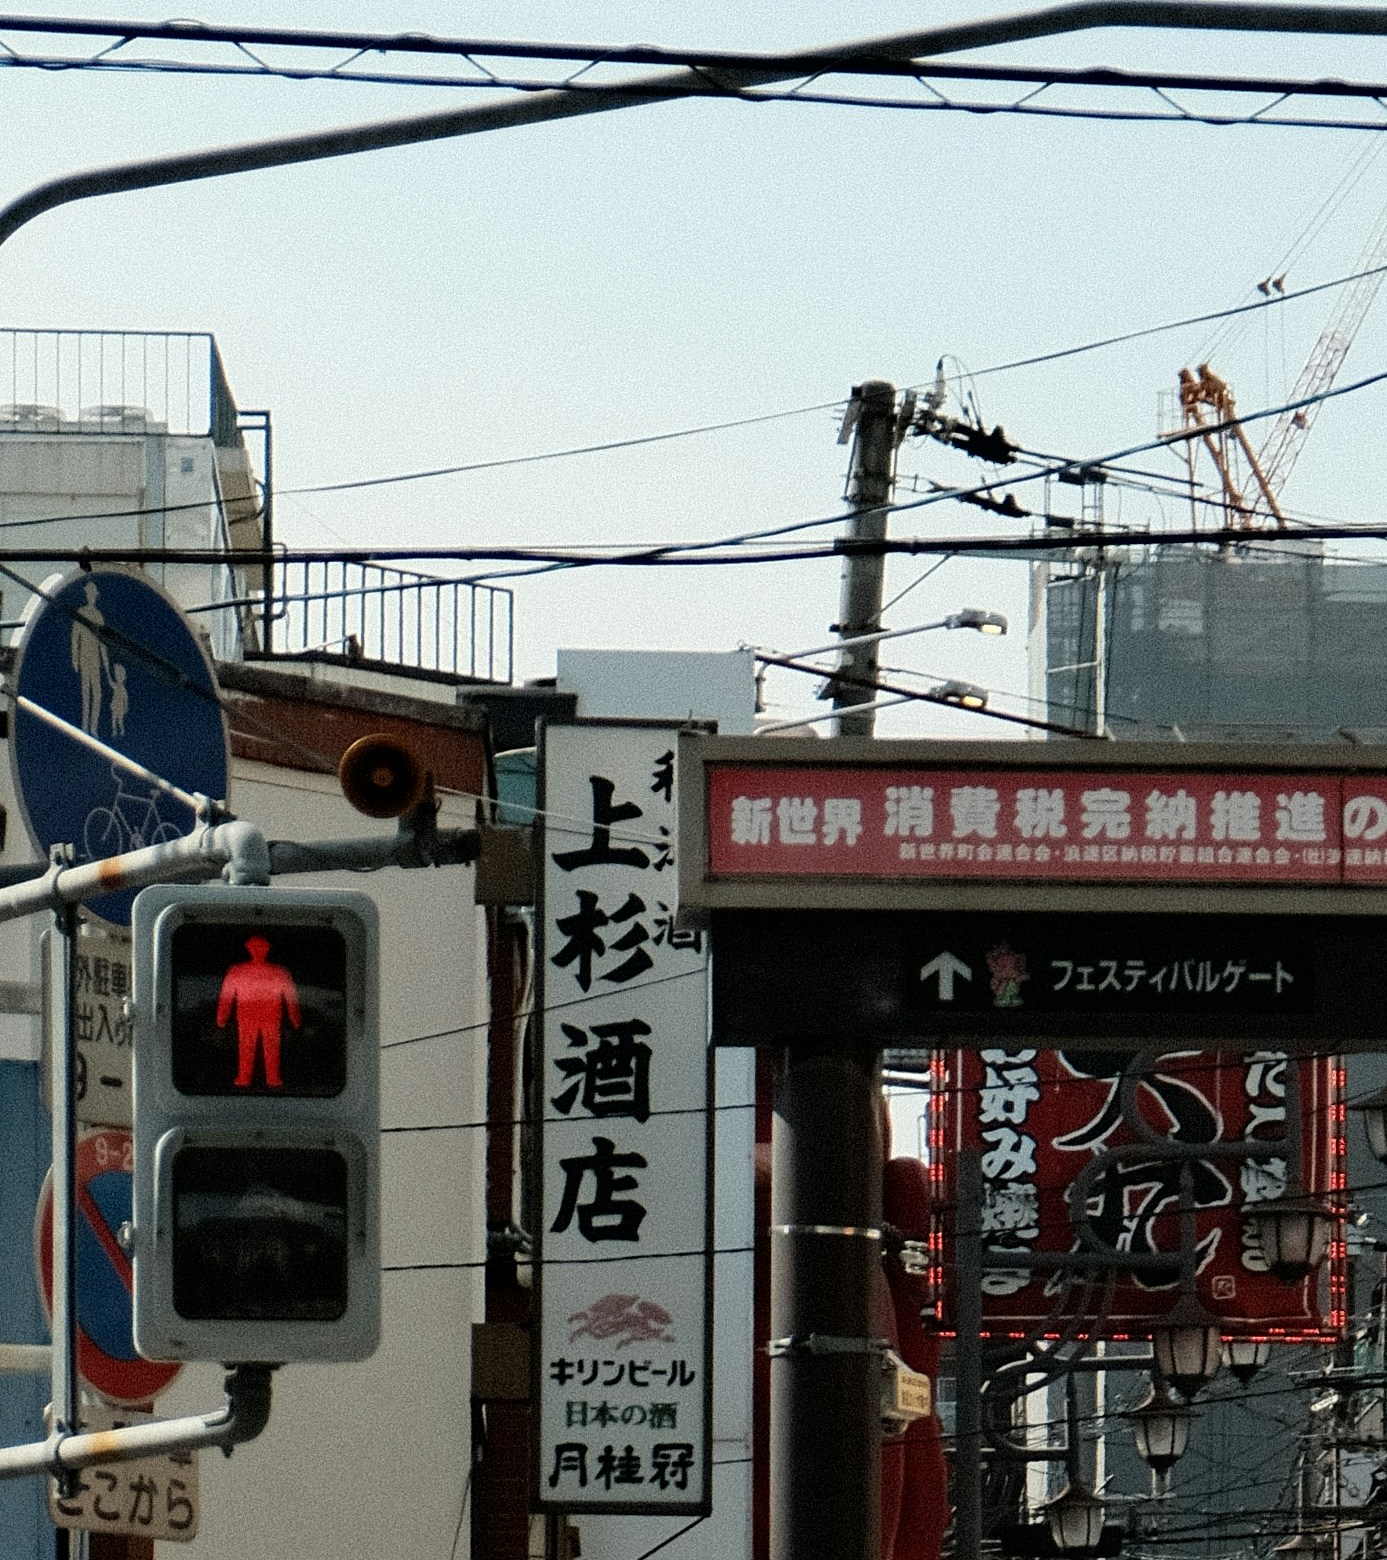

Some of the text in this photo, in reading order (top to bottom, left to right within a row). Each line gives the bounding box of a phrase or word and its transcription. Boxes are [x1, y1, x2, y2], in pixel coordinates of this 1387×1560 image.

[731, 796, 862, 846] 新世界
[1051, 959, 1294, 995] フェスティバルゲート
[550, 775, 652, 1244] 上杉酒店
[549, 1357, 697, 1390] キリンビール
[565, 1400, 678, 1430] 日本の酒
[548, 1442, 695, 1491] 月桂冠
